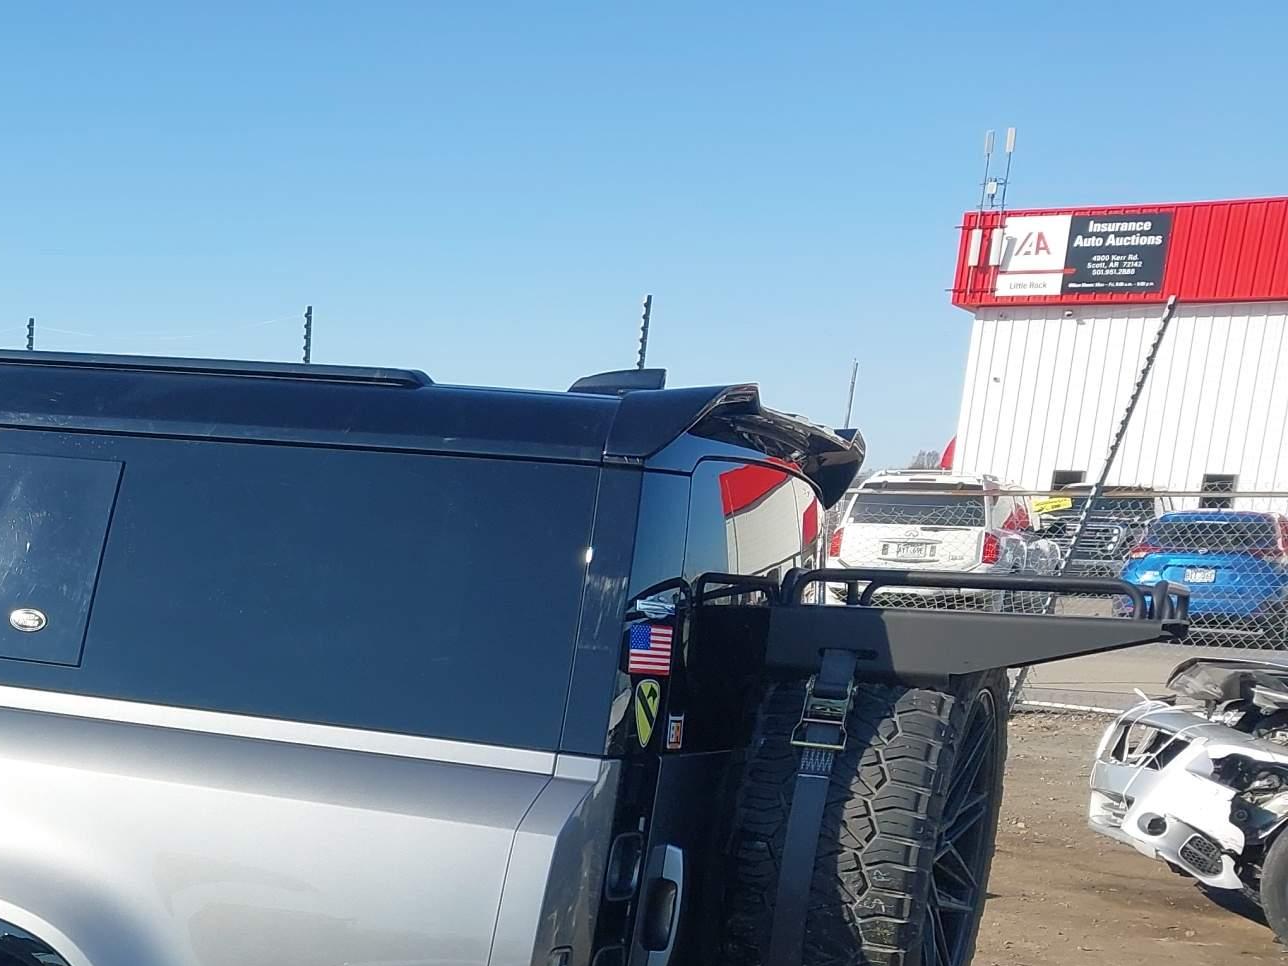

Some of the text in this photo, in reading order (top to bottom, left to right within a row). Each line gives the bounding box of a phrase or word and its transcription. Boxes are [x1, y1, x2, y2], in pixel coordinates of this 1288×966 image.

[1088, 220, 1152, 232] Insurance
[1073, 233, 1163, 247] Auto Auctions
[1009, 281, 1028, 289] Little
